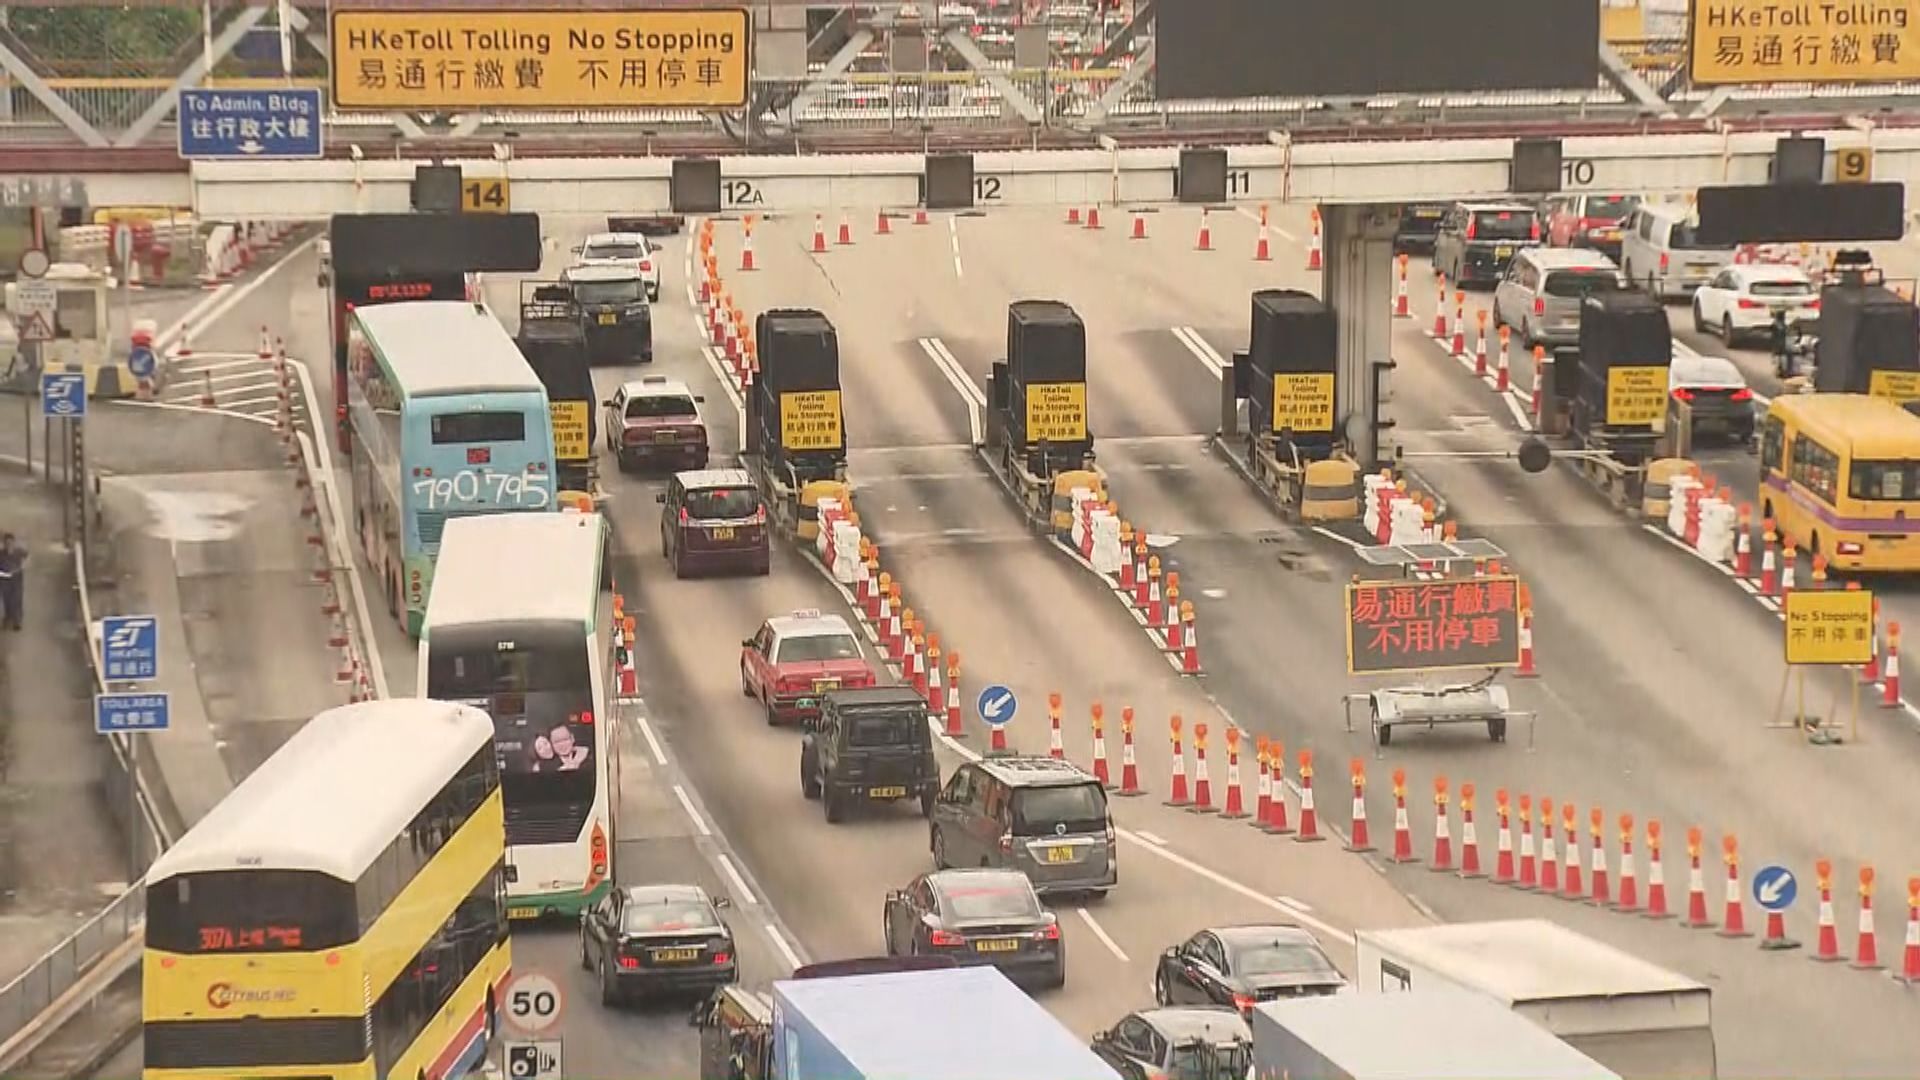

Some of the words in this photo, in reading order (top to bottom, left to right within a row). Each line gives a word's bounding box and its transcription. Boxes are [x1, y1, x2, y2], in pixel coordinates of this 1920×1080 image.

[1708, 5, 1811, 27] HKeToll
[1819, 5, 1908, 28] Tolling
[349, 29, 453, 50] HKeToll
[461, 29, 550, 54] Tolling
[569, 28, 605, 50] No
[615, 27, 734, 54] Stopping
[1715, 34, 1900, 66] 易通行繳費
[357, 57, 544, 91] 易通行繳費
[577, 57, 723, 90] 不用停車
[186, 95, 207, 111] To
[1563, 160, 1594, 185] 10
[1846, 151, 1865, 176] 9
[465, 182, 505, 208] 14
[723, 181, 764, 204] 12A
[975, 177, 1001, 200] 12
[1227, 172, 1250, 194] 11
[413, 470, 479, 509] 790
[486, 469, 549, 508] 795
[1790, 611, 1807, 621] No
[1811, 609, 1868, 623] Stopping
[1367, 616, 1501, 656] 不用停車
[512, 991, 555, 1017] 50
